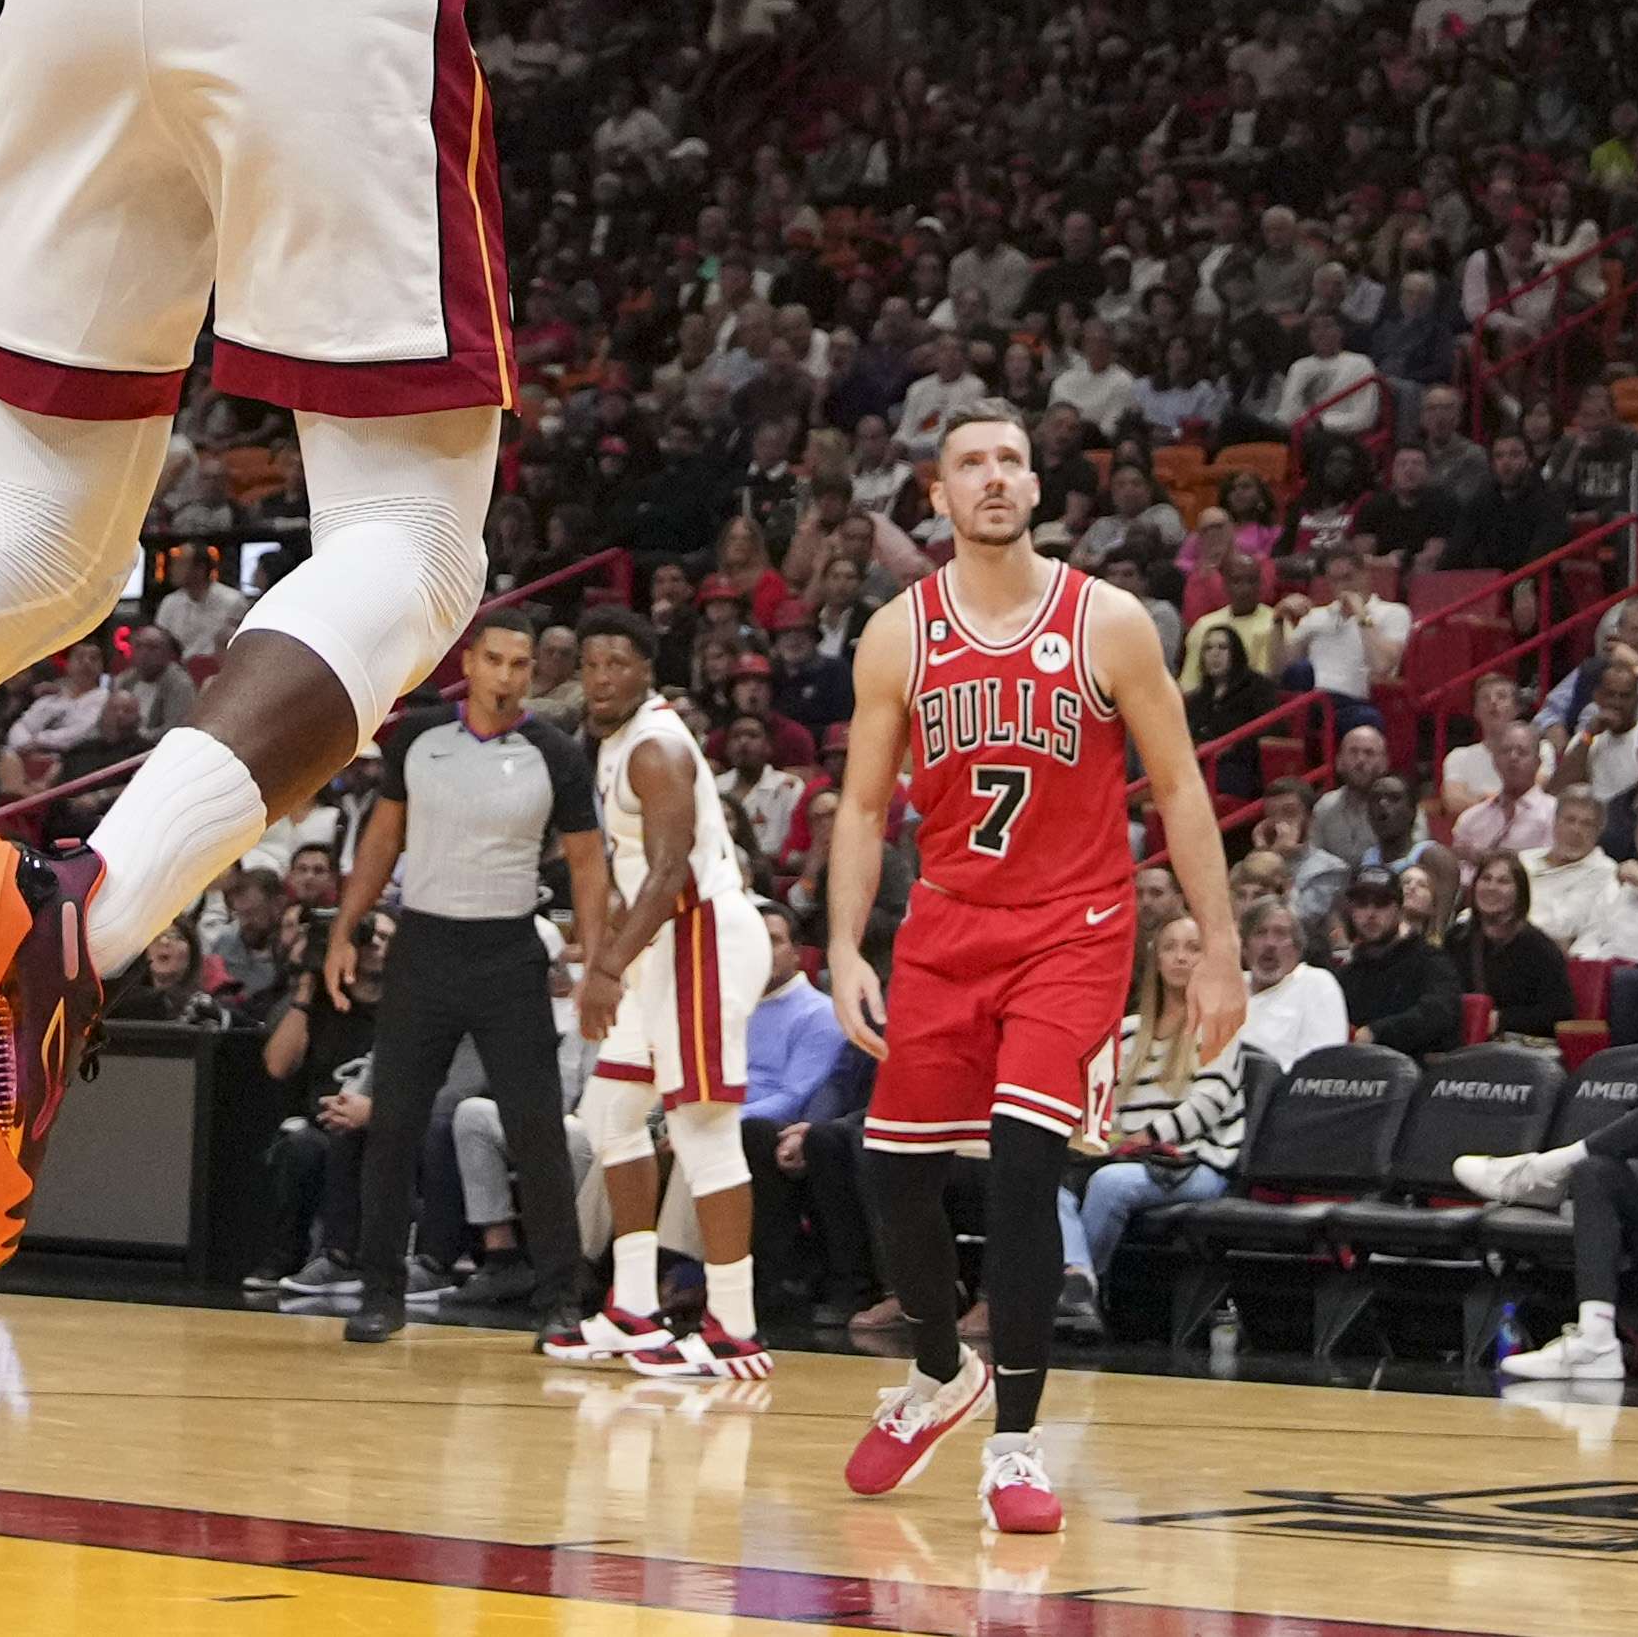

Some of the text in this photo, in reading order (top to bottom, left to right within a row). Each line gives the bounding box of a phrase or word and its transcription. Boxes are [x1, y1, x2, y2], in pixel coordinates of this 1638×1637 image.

[917, 677, 1082, 769] BULLS
[968, 764, 1032, 858] 7
[1289, 1077, 1388, 1098] AMERANT
[1430, 1079, 1533, 1103] AMERANT
